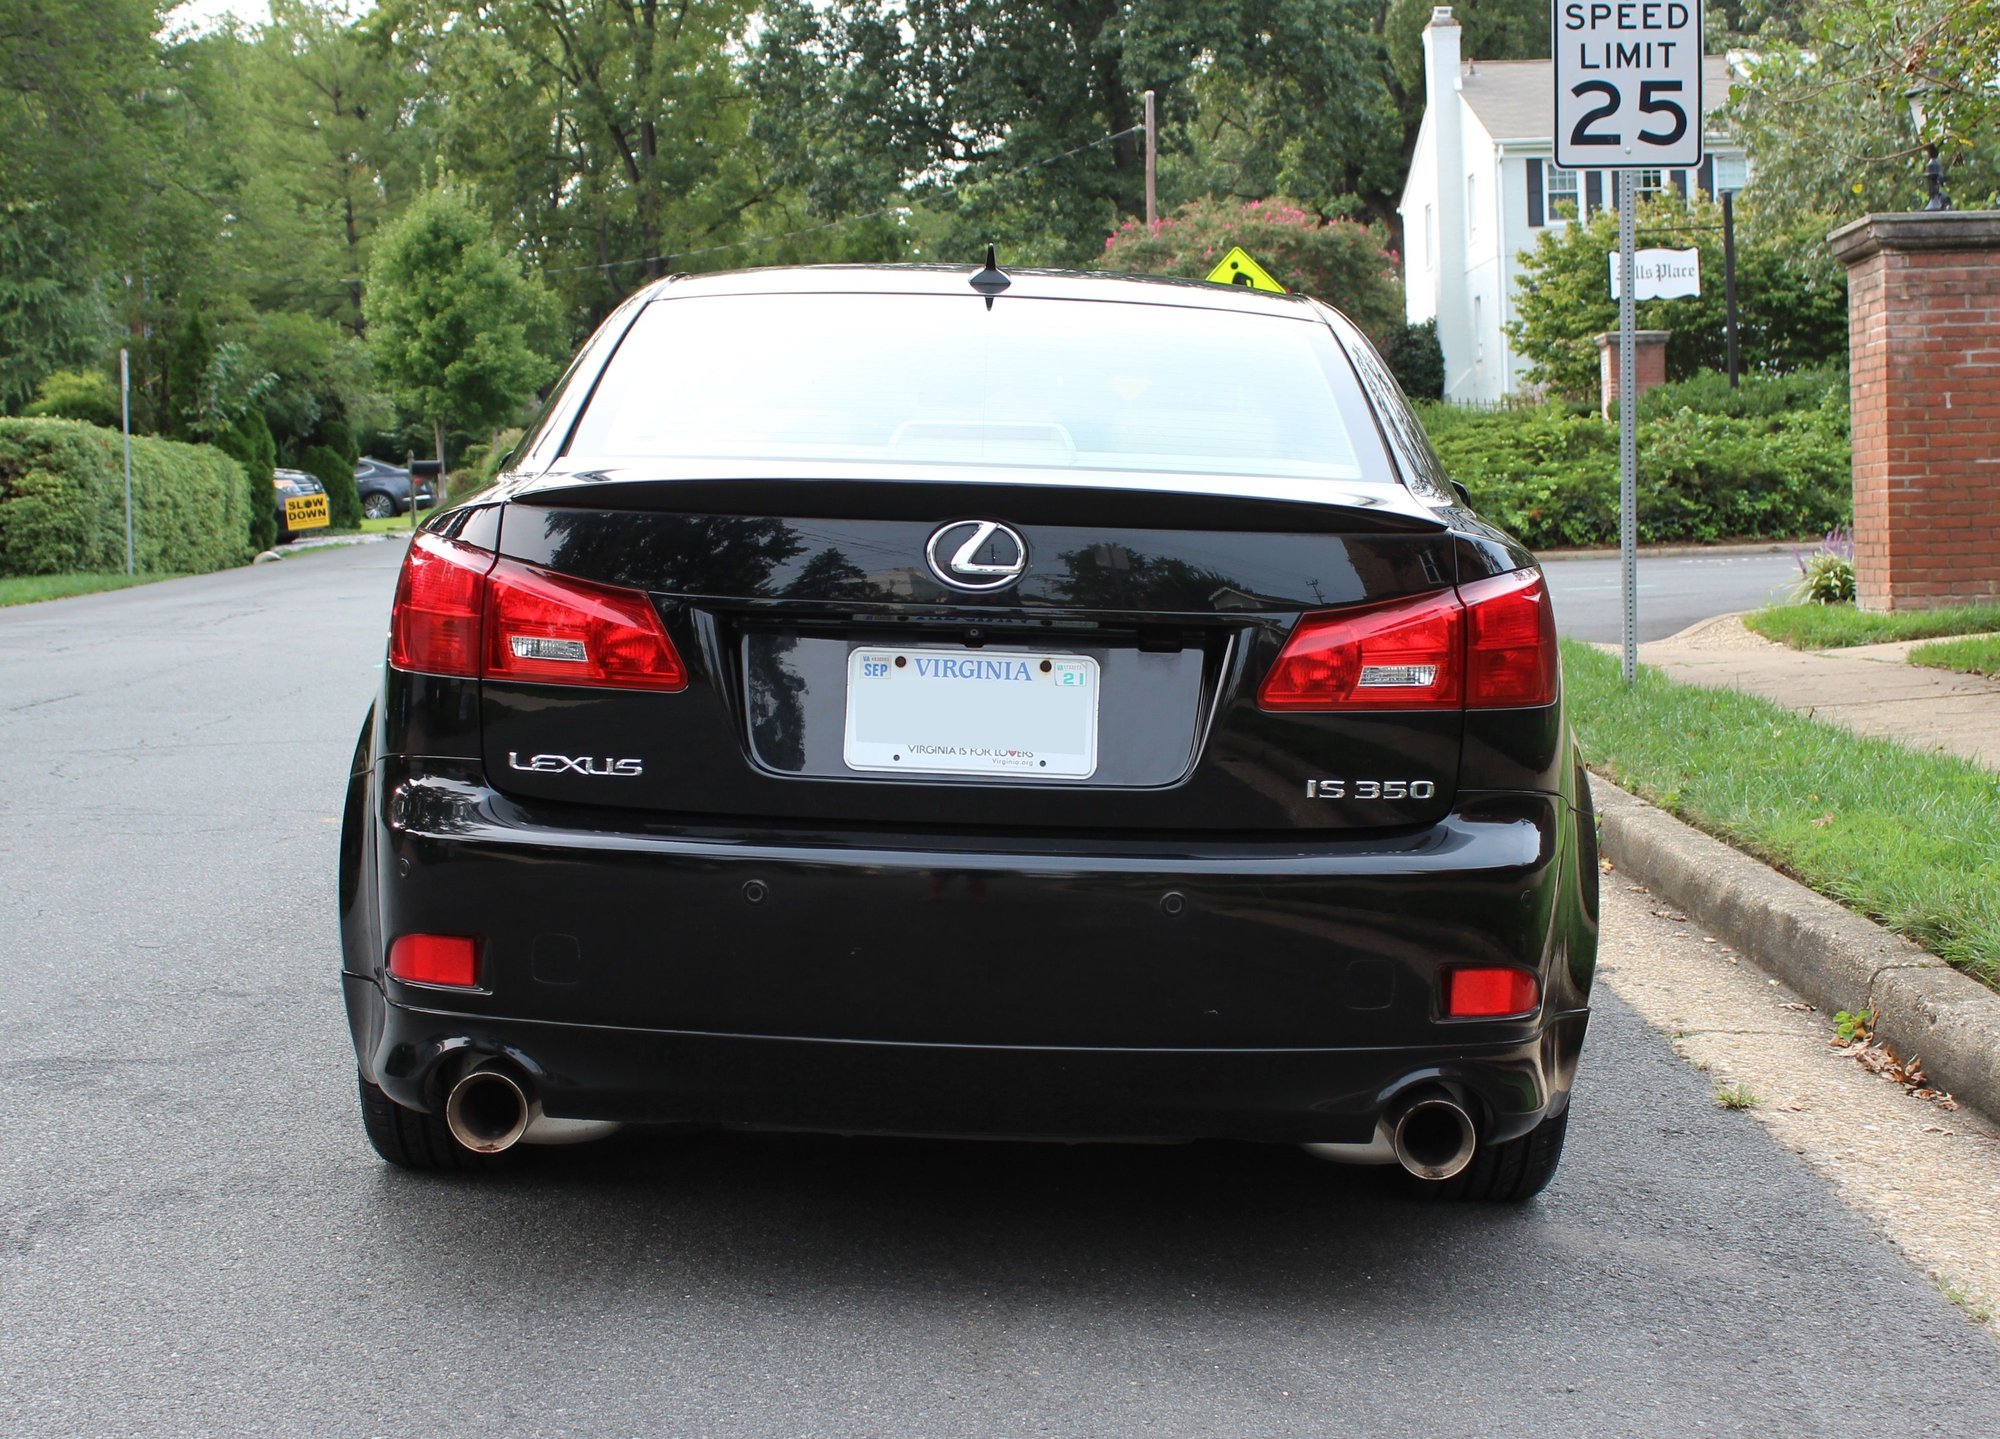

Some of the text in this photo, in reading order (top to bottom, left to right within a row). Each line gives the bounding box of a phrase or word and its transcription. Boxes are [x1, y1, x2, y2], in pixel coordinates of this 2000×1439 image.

[1565, 3, 1689, 31] SPEED
[1580, 41, 1677, 70] LIMIT
[1570, 79, 1688, 146] 25
[1655, 263, 1695, 282] Place
[288, 498, 324, 510] SLOW
[288, 509, 326, 520] DOWN
[863, 663, 888, 677] SEP
[914, 658, 1033, 682] VIRGINIA
[1063, 672, 1085, 685] 21
[907, 744, 956, 756] VIRGINIA
[508, 751, 643, 777] LEXUS
[992, 758, 1034, 767] Virginia.org
[1306, 779, 1435, 800] IS 350
